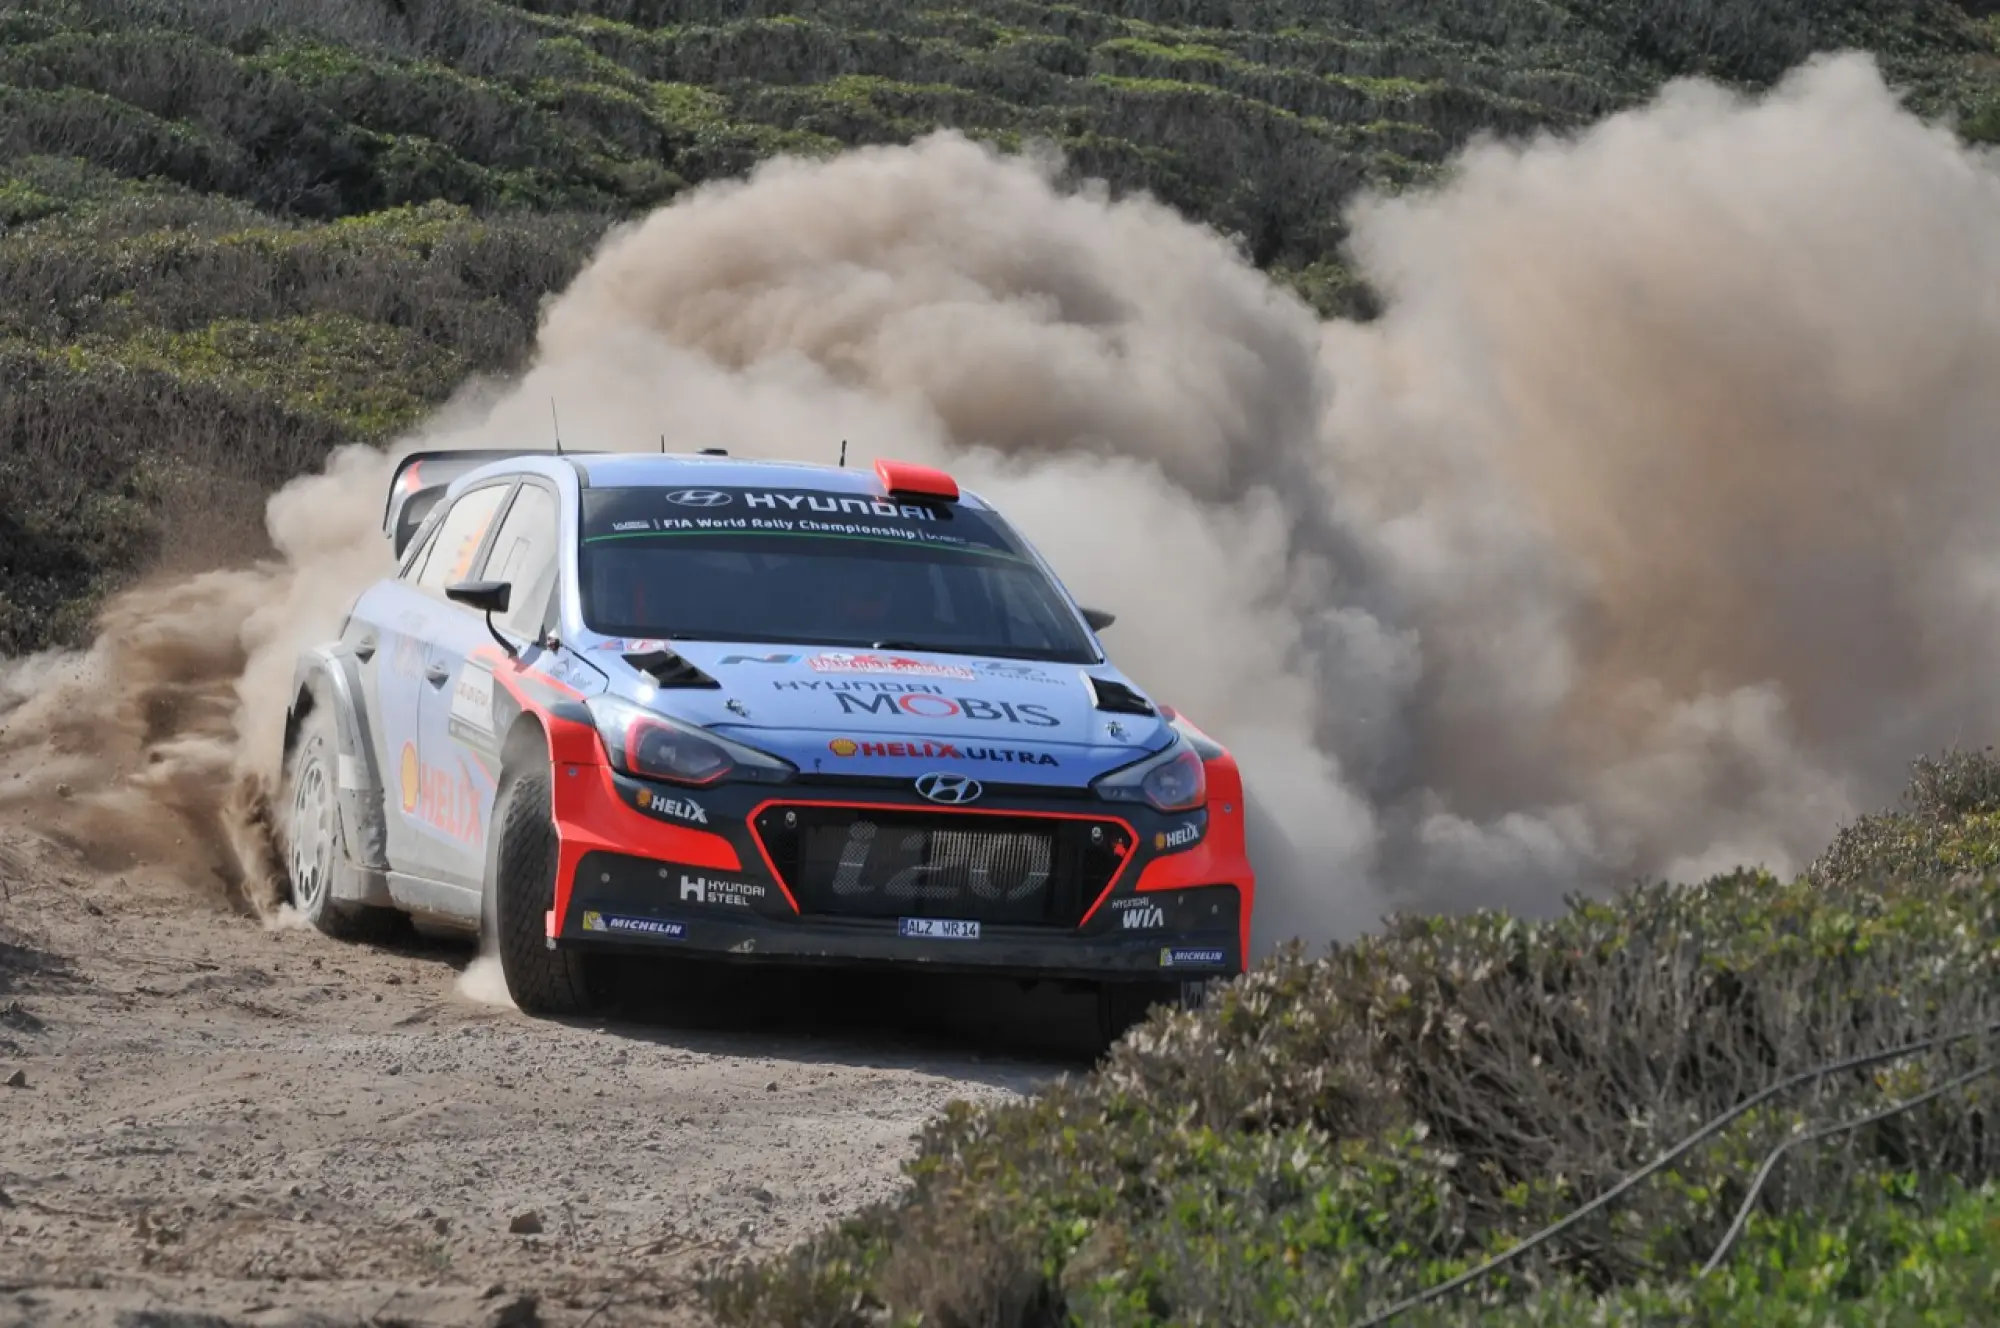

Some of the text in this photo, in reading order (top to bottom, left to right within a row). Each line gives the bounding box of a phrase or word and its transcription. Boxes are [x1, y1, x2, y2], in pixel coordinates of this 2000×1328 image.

[744, 493, 937, 521] HYUNDAI
[664, 518, 693, 529] FIA
[697, 518, 746, 528] World
[752, 518, 793, 530] Rally
[800, 519, 916, 539] Championship
[773, 680, 943, 694] HYUNDAI
[834, 692, 1061, 727] MOBIS
[863, 739, 1060, 767] HELIX ULTRA
[652, 795, 708, 823] HELIX
[1166, 822, 1199, 848] HELIX
[708, 879, 765, 898] HYUNDAI
[707, 892, 750, 906] STEEL
[609, 917, 682, 936] MICHELIN
[907, 920, 933, 936] ALZ
[1174, 951, 1223, 961] MICHELIN
